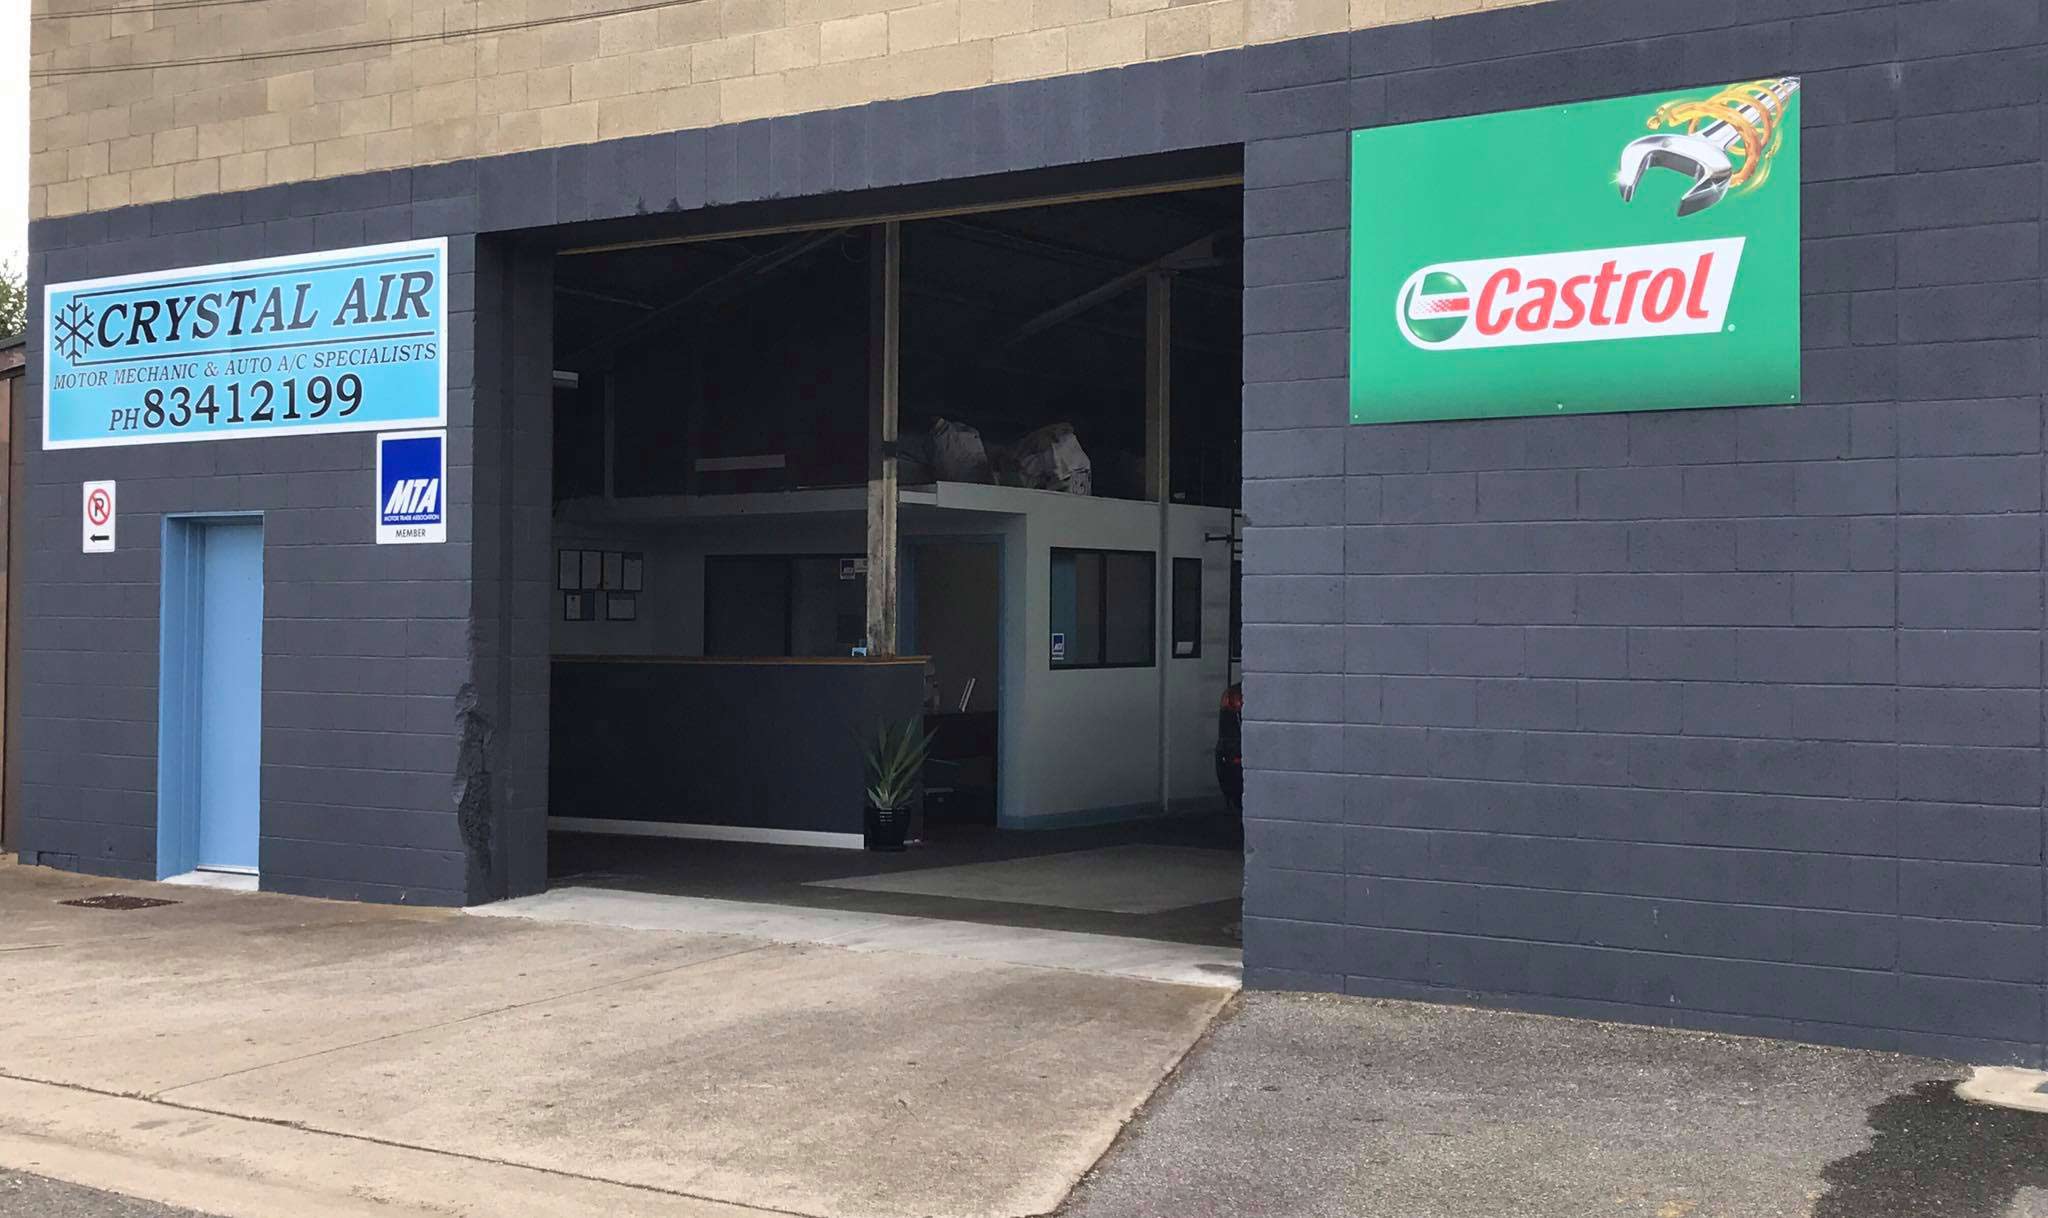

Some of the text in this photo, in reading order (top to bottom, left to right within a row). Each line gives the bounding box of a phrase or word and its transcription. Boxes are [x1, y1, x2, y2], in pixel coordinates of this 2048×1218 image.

[97, 270, 434, 349] CRYSTAL AIR
[1474, 251, 1715, 336] Castrol
[53, 343, 437, 390] MOTOR MECHANIC & AUTO A/C SPECIALISTS
[108, 373, 363, 431] PH 83412199
[384, 478, 439, 514] MTA
[395, 529, 426, 538] MEMBER
